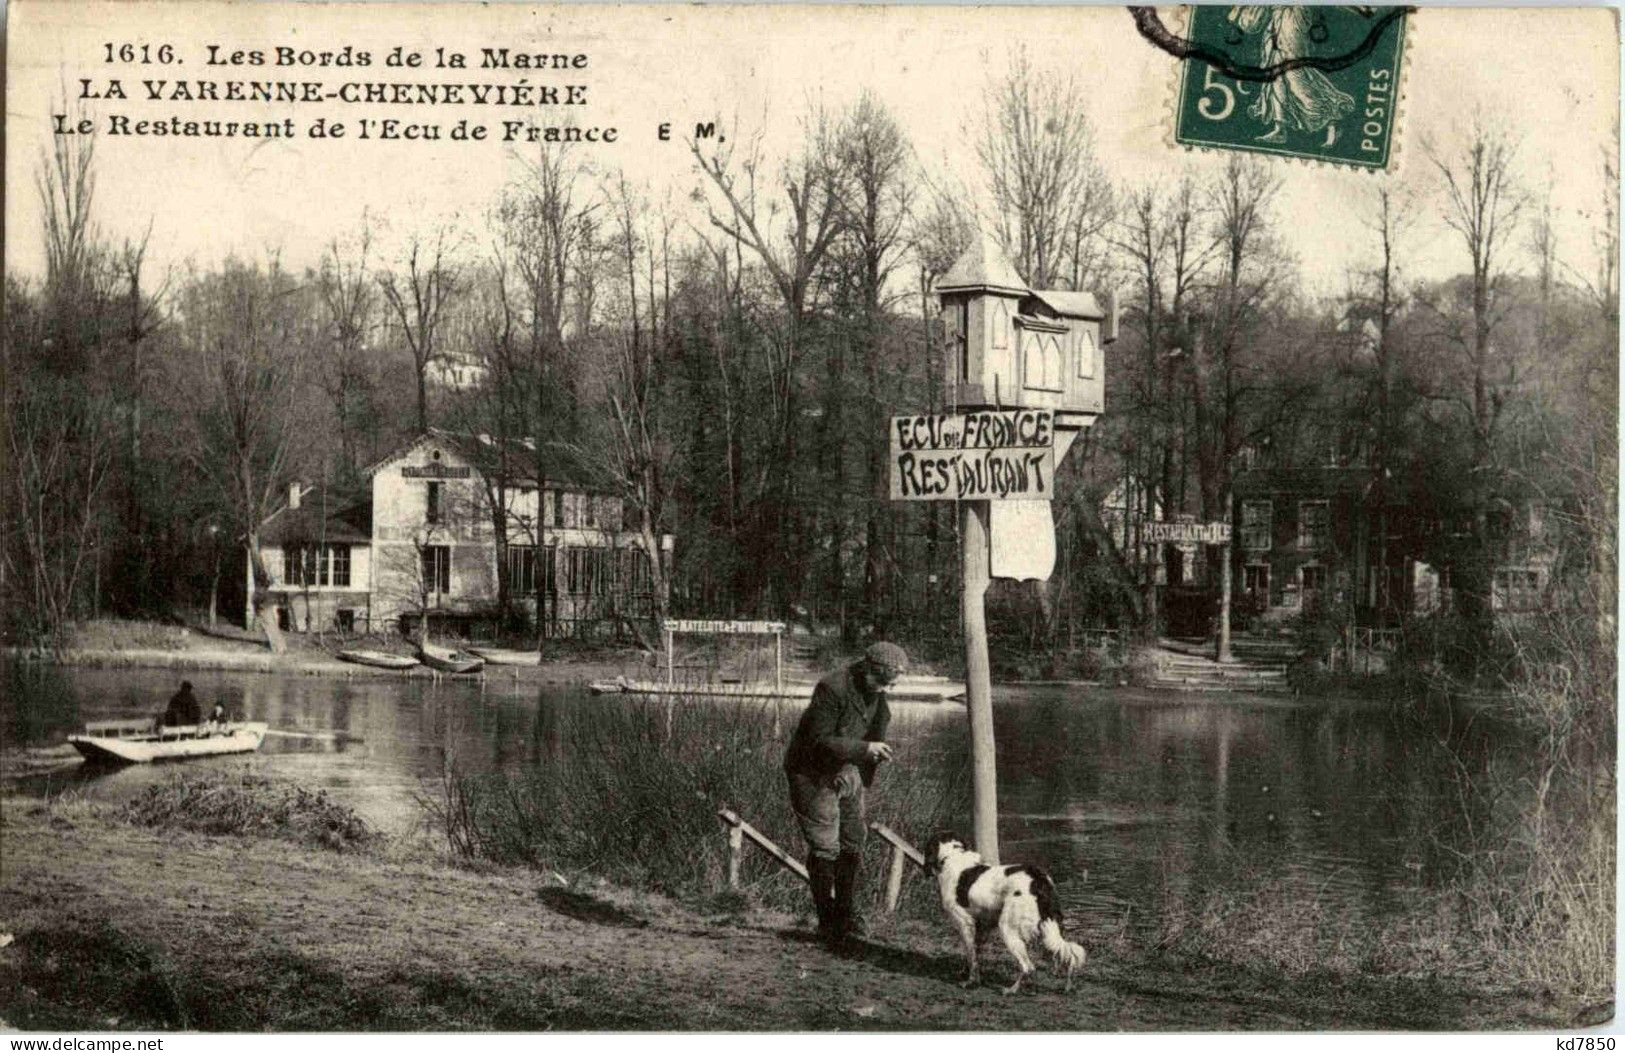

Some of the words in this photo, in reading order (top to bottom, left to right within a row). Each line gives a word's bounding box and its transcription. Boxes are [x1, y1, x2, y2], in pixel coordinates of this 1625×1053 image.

[1361, 69, 1390, 151] POSTES
[897, 414, 946, 450] ECU
[961, 410, 1050, 449] FRANCE
[898, 448, 1045, 498] RESTAURANT
